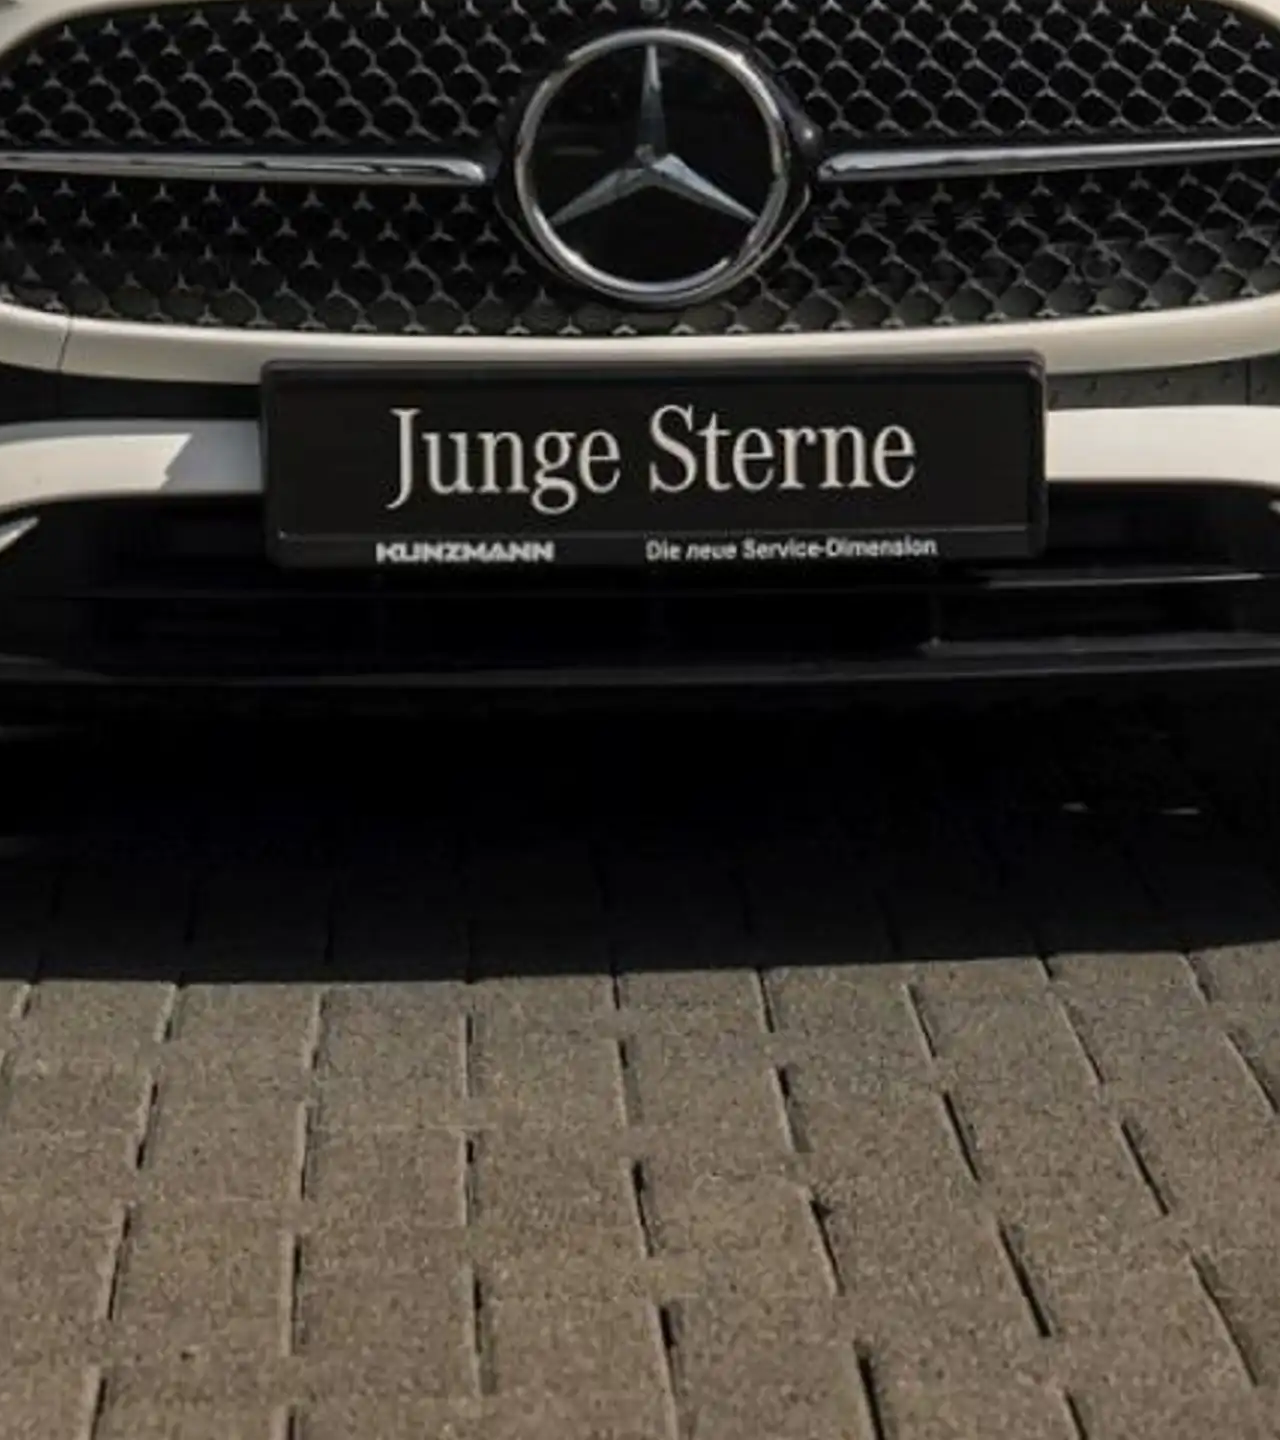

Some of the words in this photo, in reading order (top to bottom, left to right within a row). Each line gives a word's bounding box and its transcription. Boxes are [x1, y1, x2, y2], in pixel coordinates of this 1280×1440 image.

[386, 406, 621, 515] Junge
[649, 403, 916, 492] Sterne
[375, 540, 556, 564] KUNZMANN
[644, 539, 681, 561] Die
[685, 542, 738, 560] neue
[742, 535, 938, 559] Service-Dimension
